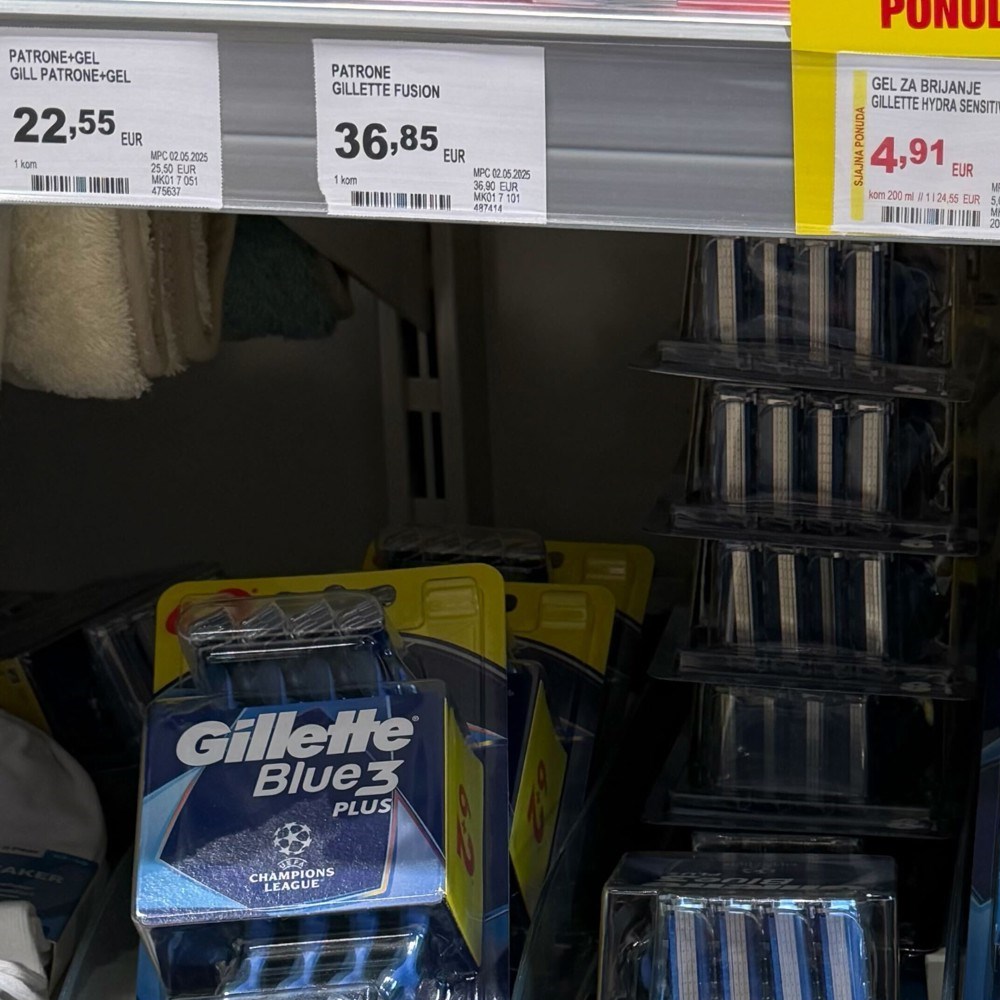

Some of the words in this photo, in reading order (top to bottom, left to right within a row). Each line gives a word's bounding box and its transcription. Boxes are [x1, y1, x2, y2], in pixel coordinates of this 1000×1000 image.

[9, 49, 99, 64] PATRONE+GEL
[11, 67, 37, 80] GILL
[41, 68, 131, 83] PATRONE+GEL
[332, 64, 390, 79] PATRONE
[332, 82, 390, 96] GILLETTE
[395, 84, 440, 98] FUSION
[872, 77, 897, 91] GEL
[901, 78, 917, 92] ZA
[921, 79, 981, 95] BRIJANJE
[872, 95, 919, 110] GILLETTE
[922, 98, 957, 112] HYDRA
[13, 107, 115, 143] 22,55
[121, 132, 143, 146] EUR
[855, 106, 865, 148] PONUDA
[335, 122, 438, 160] 36,85
[444, 149, 465, 163] EUR
[15, 160, 18, 168] 1
[21, 159, 37, 169] kom
[151, 151, 167, 161] MPC
[170, 151, 208, 162] 02.05.2025
[870, 137, 944, 173] 4,91
[952, 163, 973, 177] EUR
[178, 164, 196, 174] EUR
[474, 168, 490, 178] MPC
[493, 169, 530, 179] 02.05.2025
[854, 150, 864, 187] SJAJNA
[152, 175, 174, 184] MK01
[177, 176, 180, 184] 7
[184, 176, 198, 185] 051
[335, 176, 338, 184] 1
[341, 175, 357, 185] kom
[500, 182, 518, 191] EUR
[152, 187, 180, 196] 475637
[474, 192, 496, 202] MK01
[499, 193, 503, 202] 7
[507, 194, 520, 203] 101
[869, 190, 886, 200] kom
[887, 191, 902, 200] 200
[905, 191, 913, 201] ml
[474, 204, 502, 212] 487414
[176, 709, 414, 766] Gillette
[332, 798, 392, 818] PLUS
[249, 867, 335, 883] CHAMPIONS
[264, 879, 320, 892] LEAGUE
